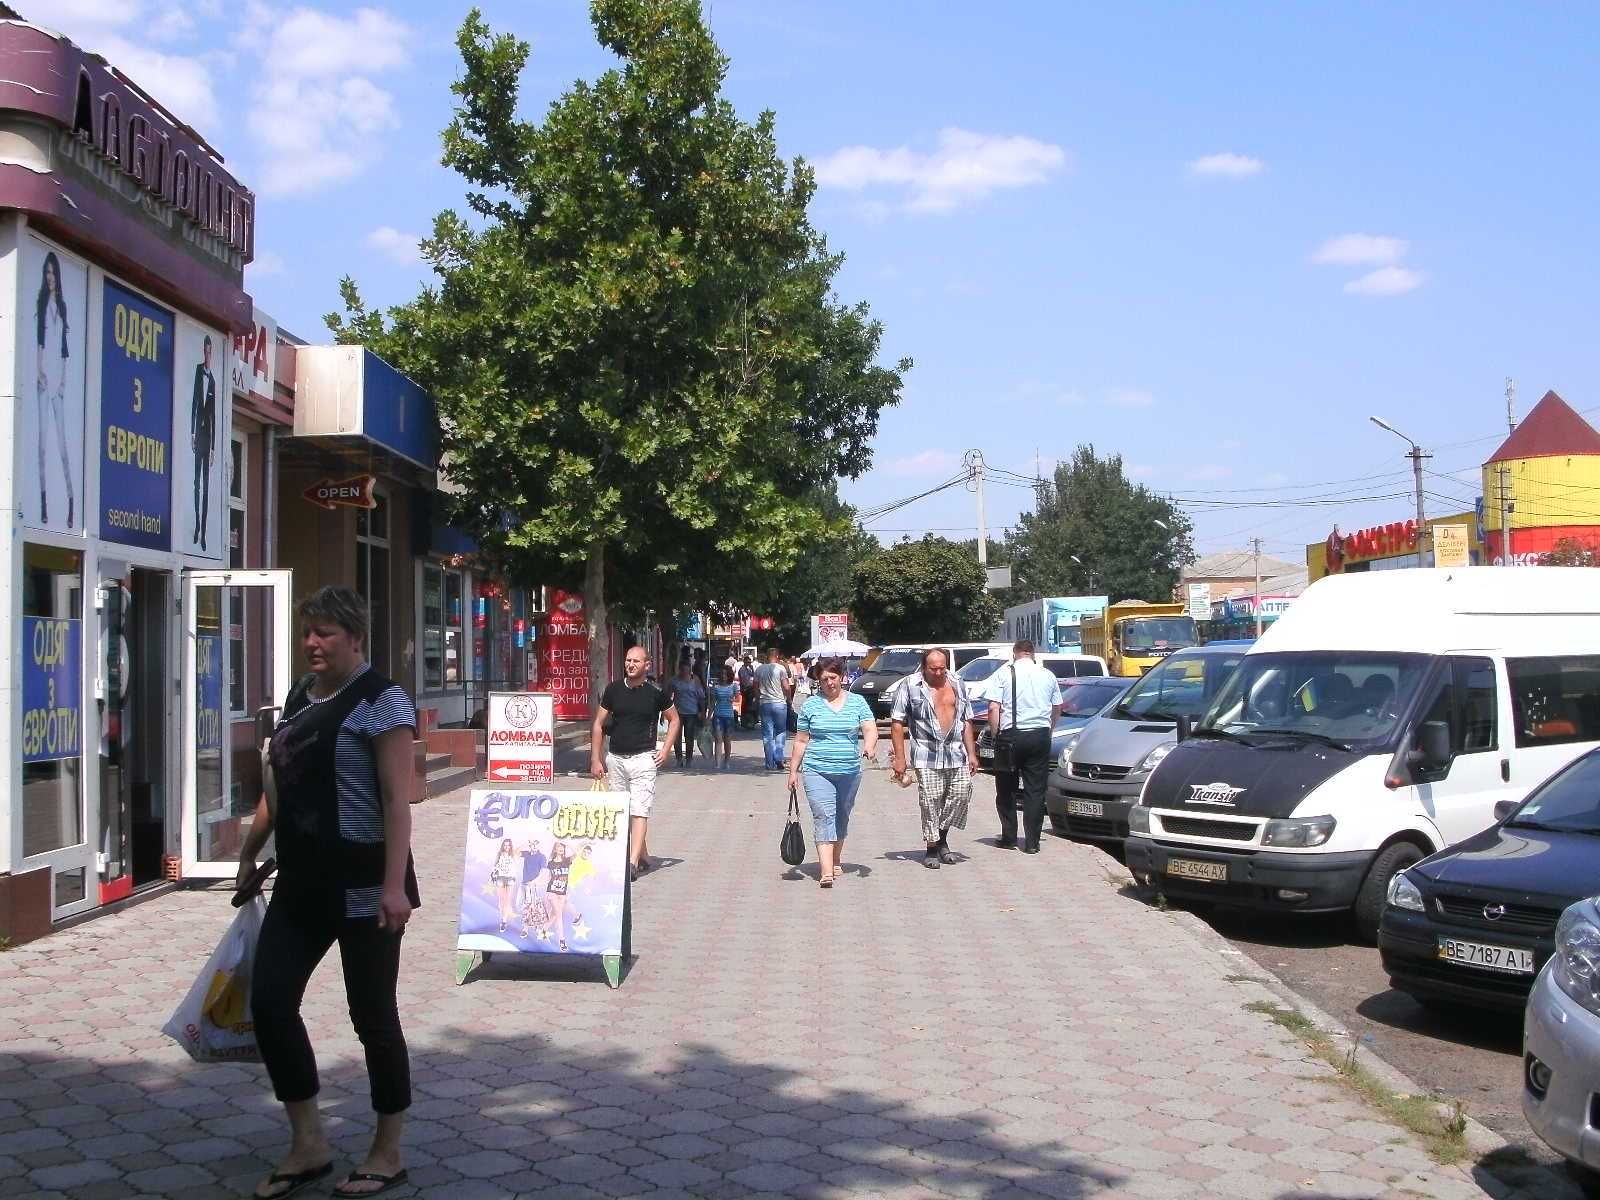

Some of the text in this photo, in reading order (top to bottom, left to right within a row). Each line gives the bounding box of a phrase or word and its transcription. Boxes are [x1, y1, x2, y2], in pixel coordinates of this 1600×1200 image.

[114, 304, 162, 362] ОДЯГ
[107, 425, 164, 474] ЄВРОПИ
[318, 487, 360, 498] OPEN
[108, 508, 161, 535] second hand
[34, 620, 69, 673] ОДЯГ
[23, 708, 78, 755] ЄВРОПИ
[490, 731, 551, 743] ЛОМБАРД
[1190, 786, 1237, 803] Transit
[1173, 860, 1225, 879] BE 4544 AX
[1446, 940, 1465, 959] BE
[1469, 944, 1501, 965] 7187
[1505, 950, 1525, 969] AI
